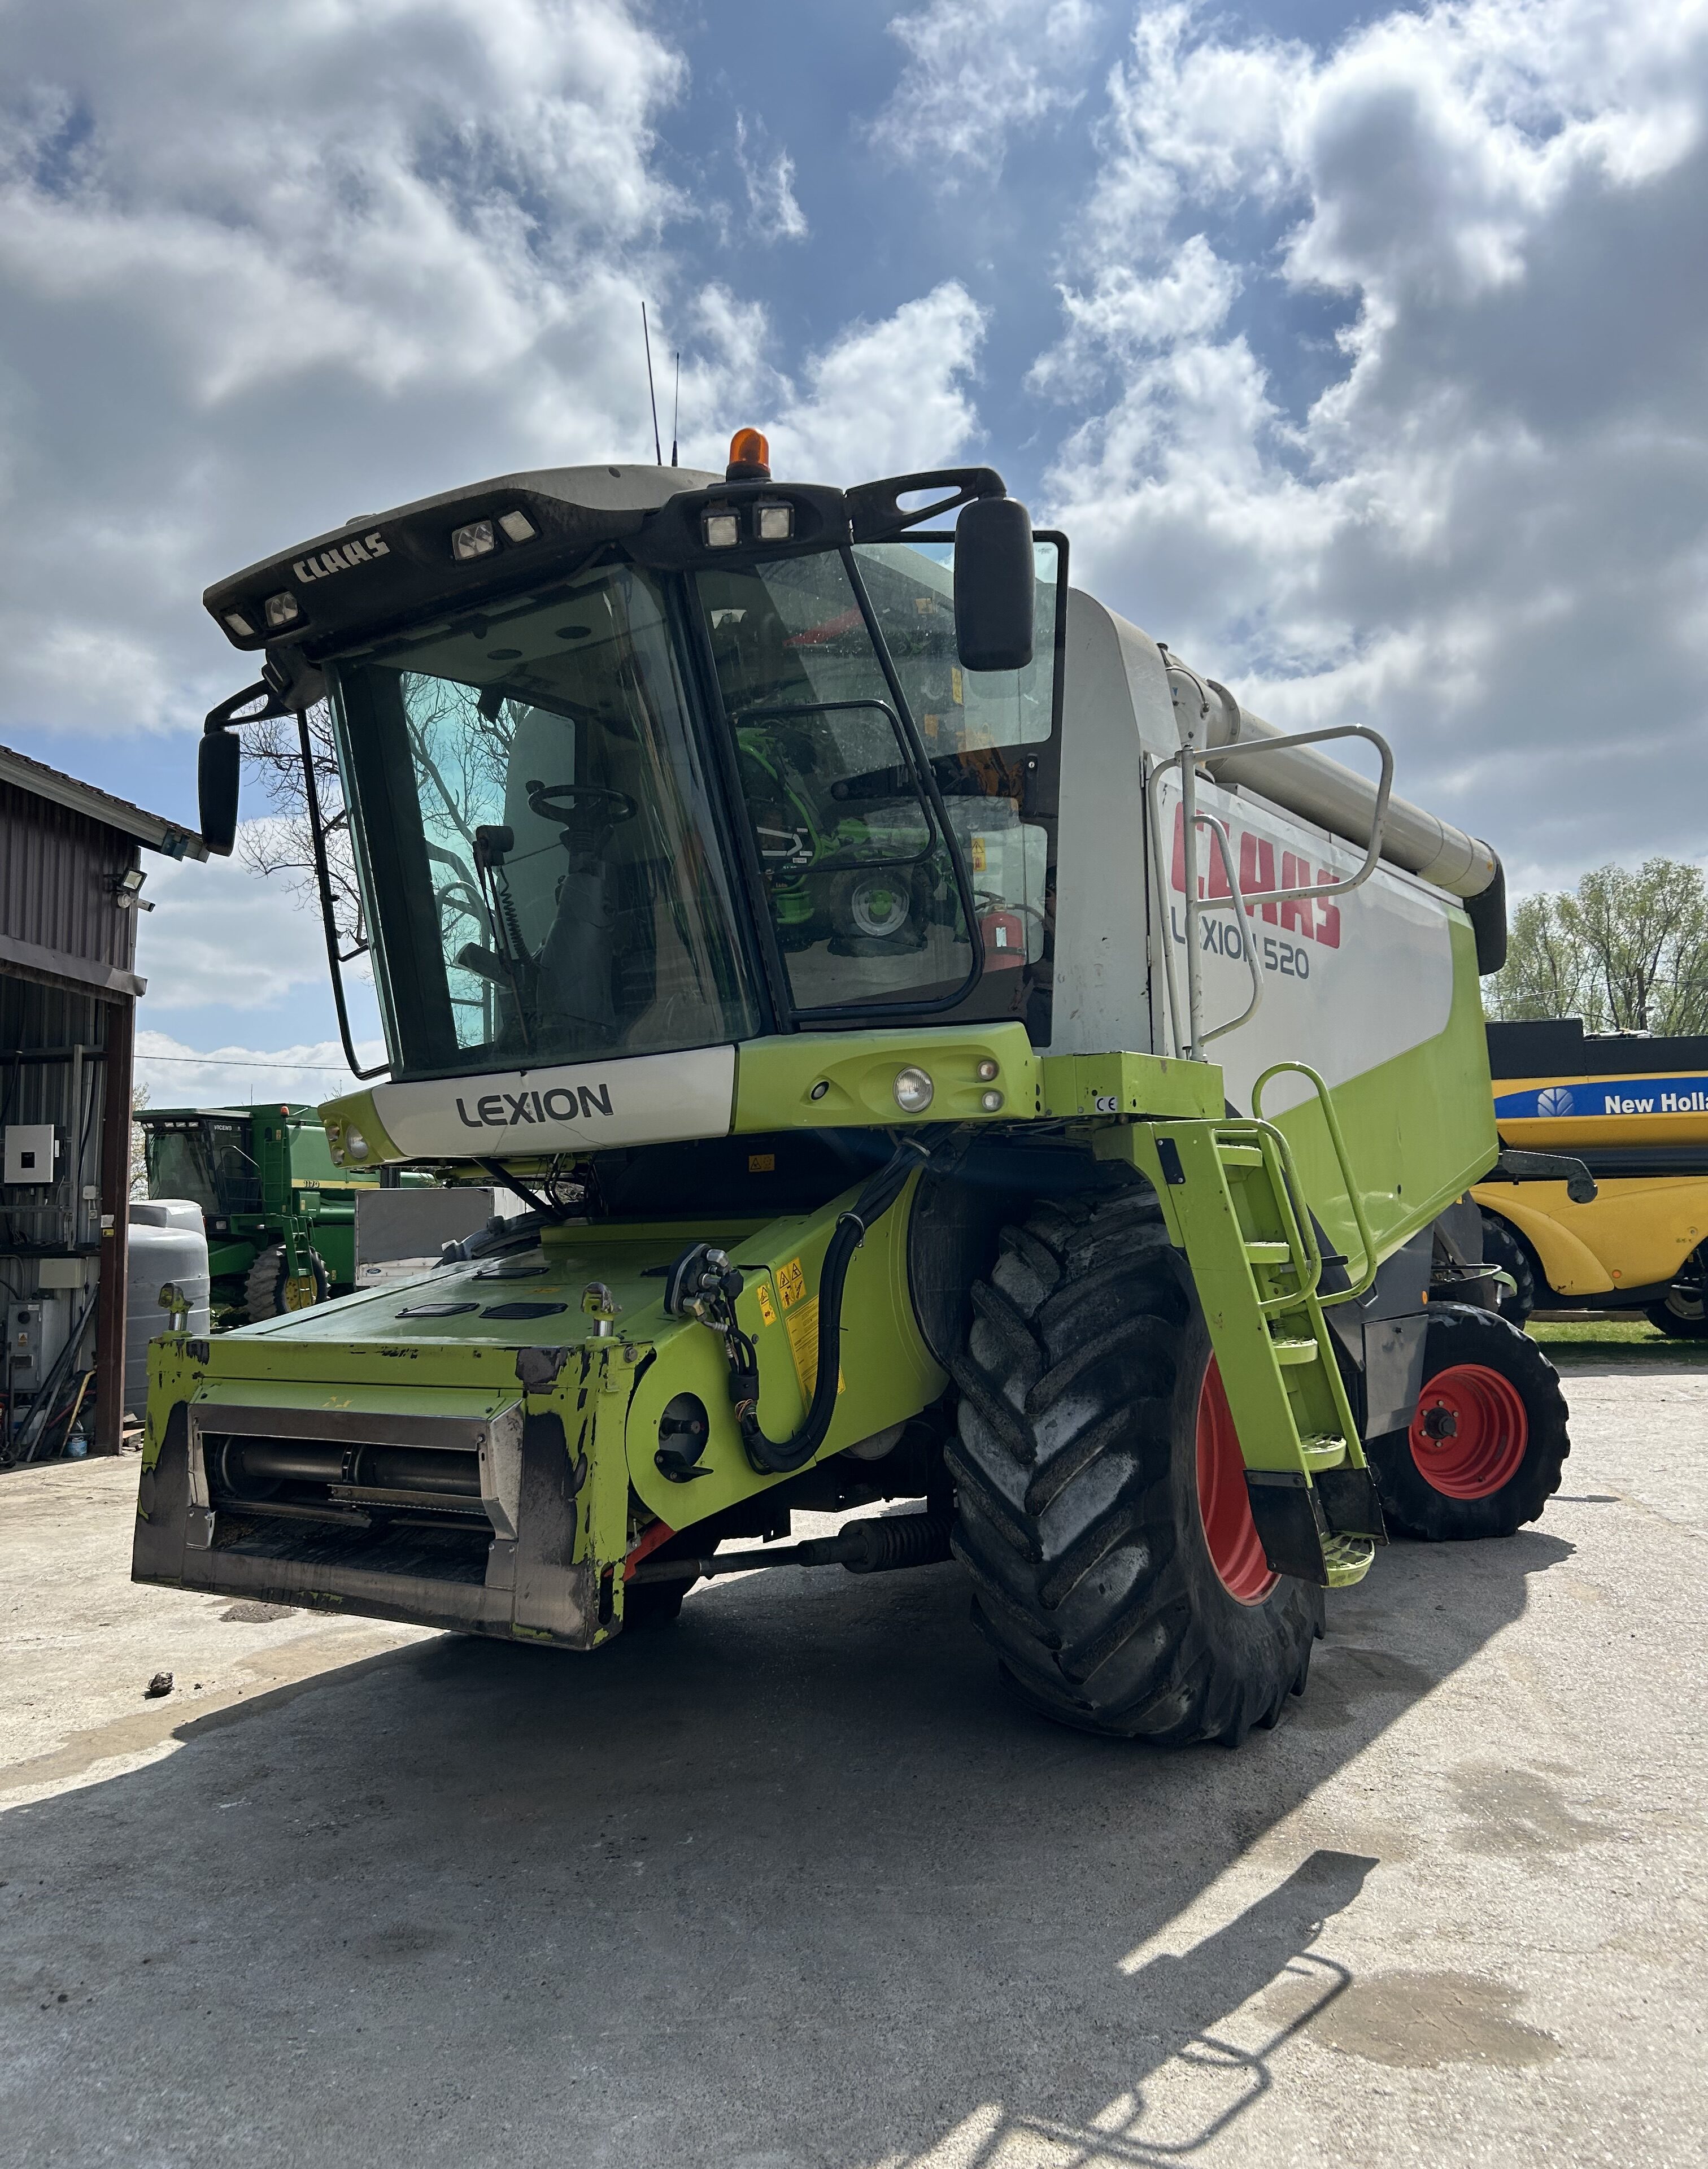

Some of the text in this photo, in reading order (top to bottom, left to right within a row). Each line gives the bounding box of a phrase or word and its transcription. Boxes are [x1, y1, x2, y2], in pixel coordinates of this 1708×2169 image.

[293, 532, 390, 583] CLAAS
[1263, 937, 1310, 980] 520
[455, 1083, 614, 1127] LEXION
[1096, 1097, 1116, 1112] CE
[1605, 1092, 1708, 1114] New Holl
